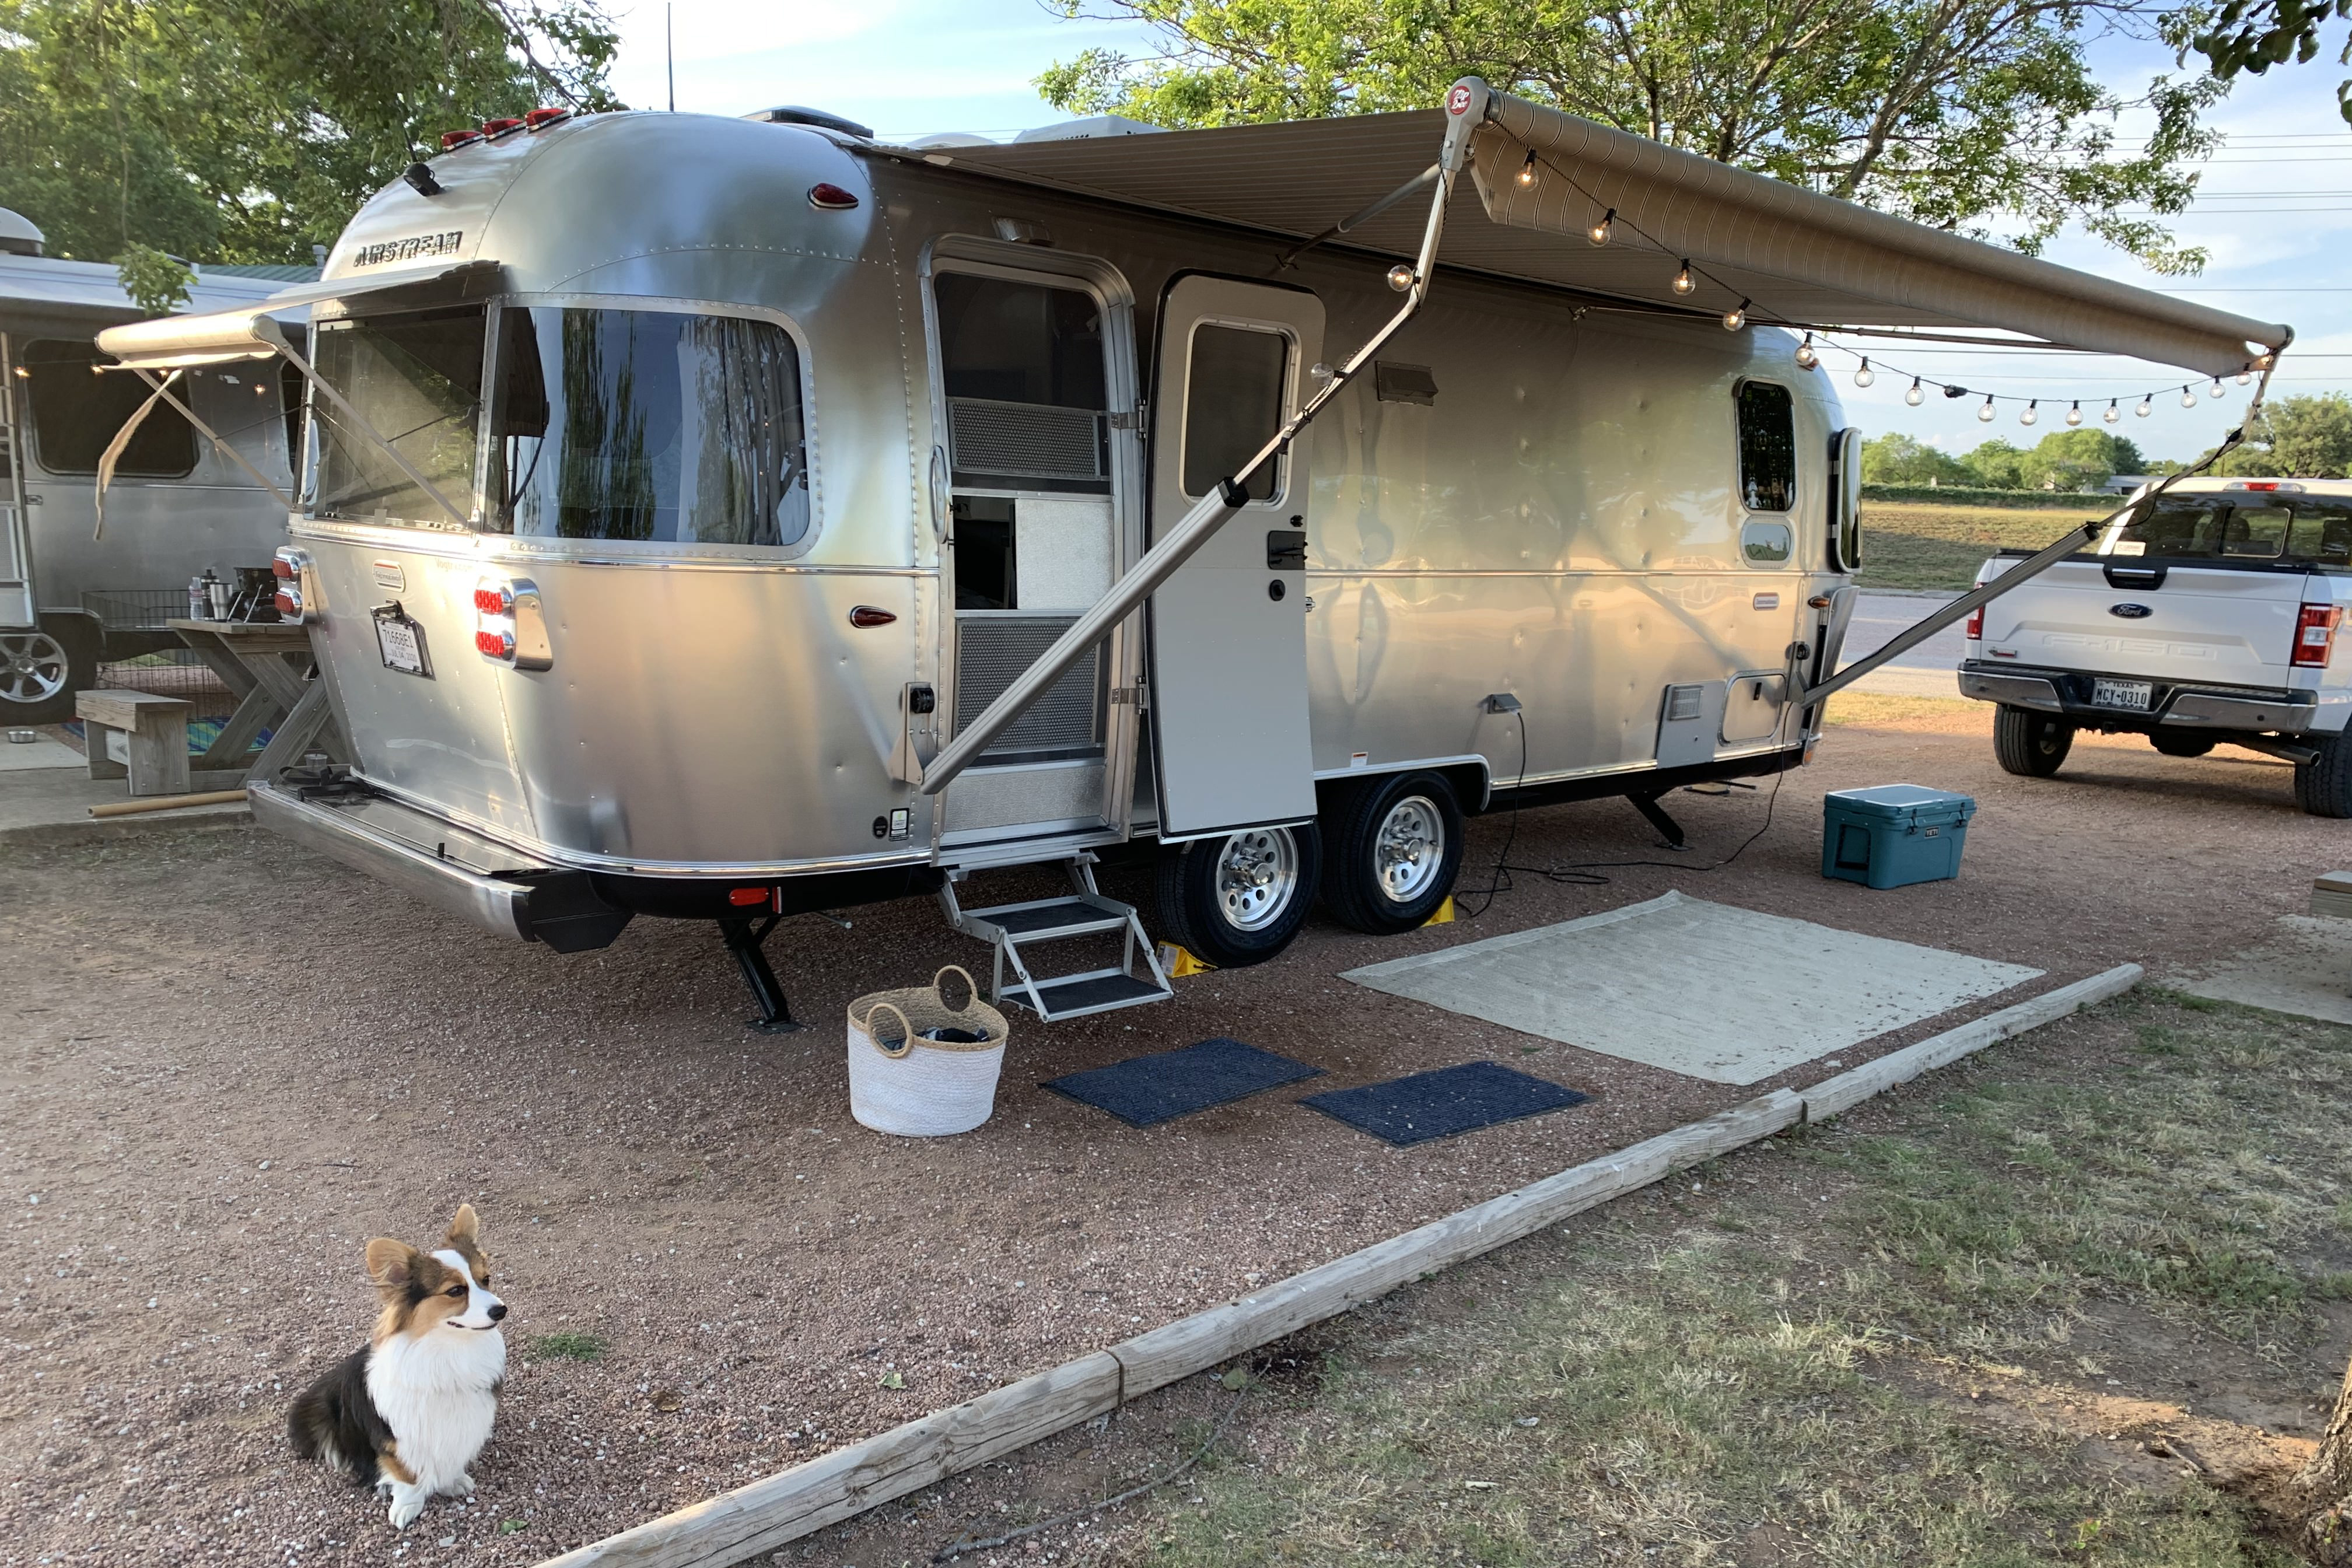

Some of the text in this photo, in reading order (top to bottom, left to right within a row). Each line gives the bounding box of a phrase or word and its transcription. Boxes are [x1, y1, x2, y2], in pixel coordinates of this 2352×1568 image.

[1454, 89, 1470, 101] Zip
[353, 230, 463, 267] AIRSTREAM
[2118, 604, 2143, 615] Ford
[383, 629, 414, 648] 71668E1
[2042, 634, 2217, 660] F-150
